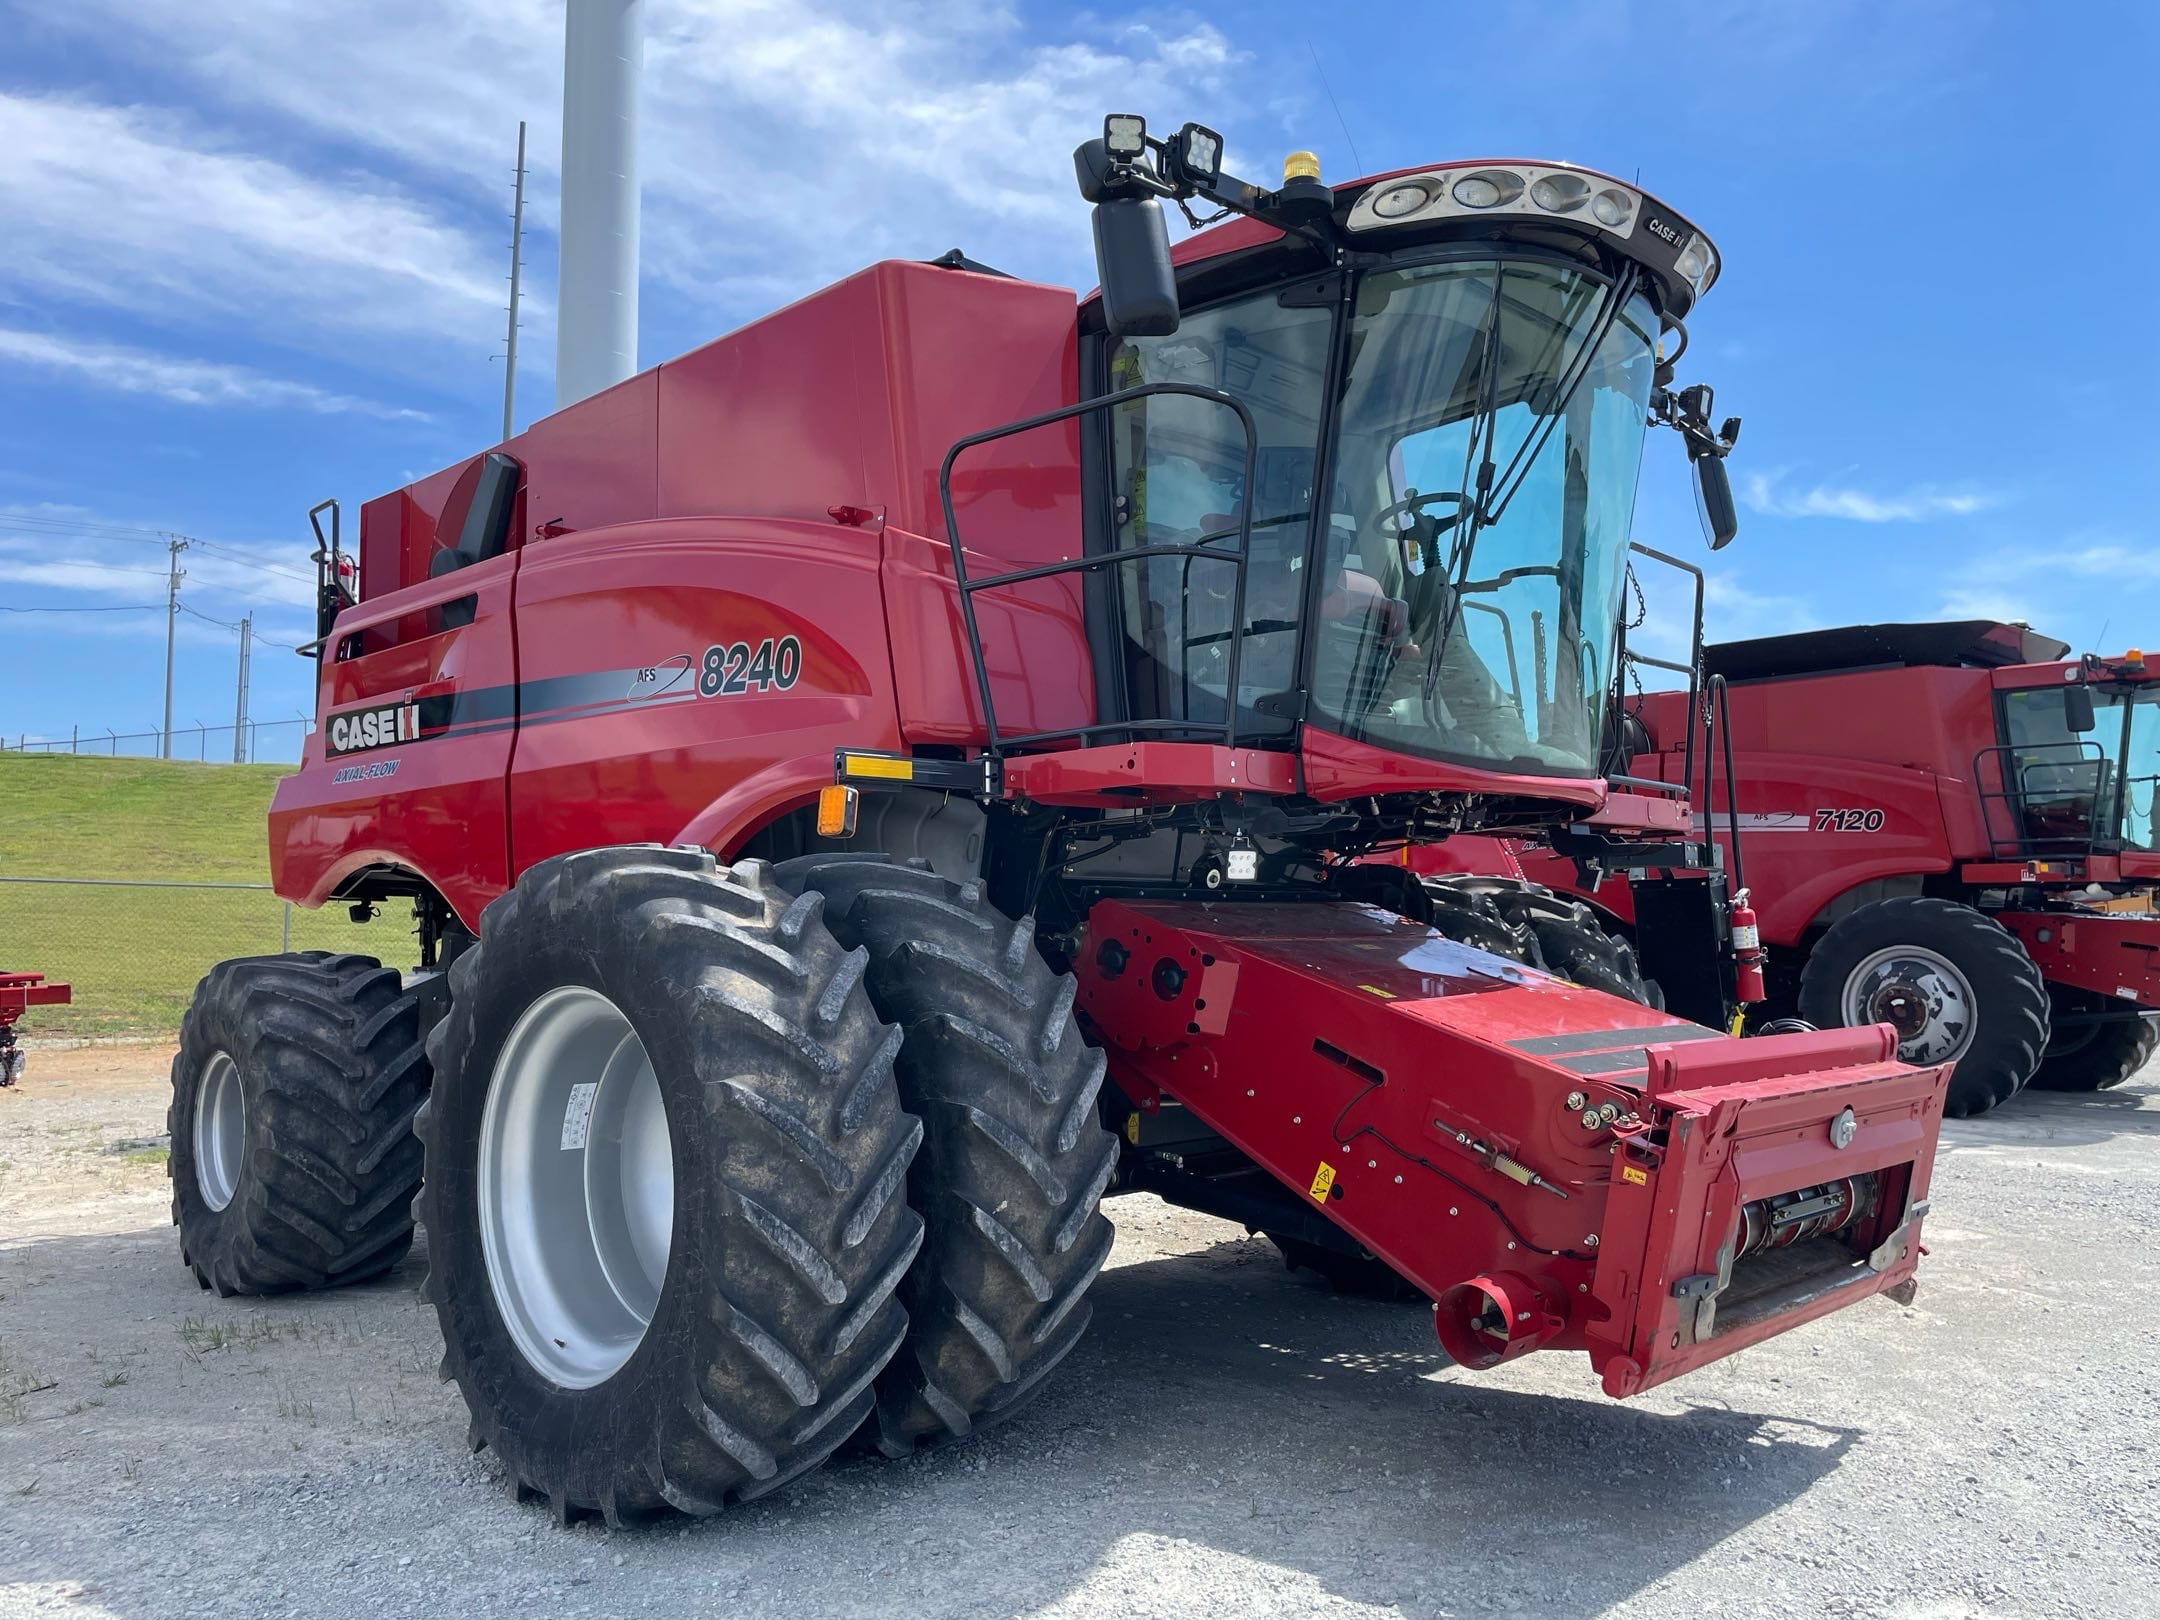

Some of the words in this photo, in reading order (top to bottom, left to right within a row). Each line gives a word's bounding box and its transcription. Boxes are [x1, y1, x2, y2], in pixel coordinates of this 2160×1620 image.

[1649, 219, 1676, 242] CASE
[637, 668, 656, 682] AFS
[698, 634, 802, 698] 8240
[332, 709, 395, 751] CASE
[332, 760, 401, 784] AXIAL-FLOW
[1815, 808, 1885, 832] 7120
